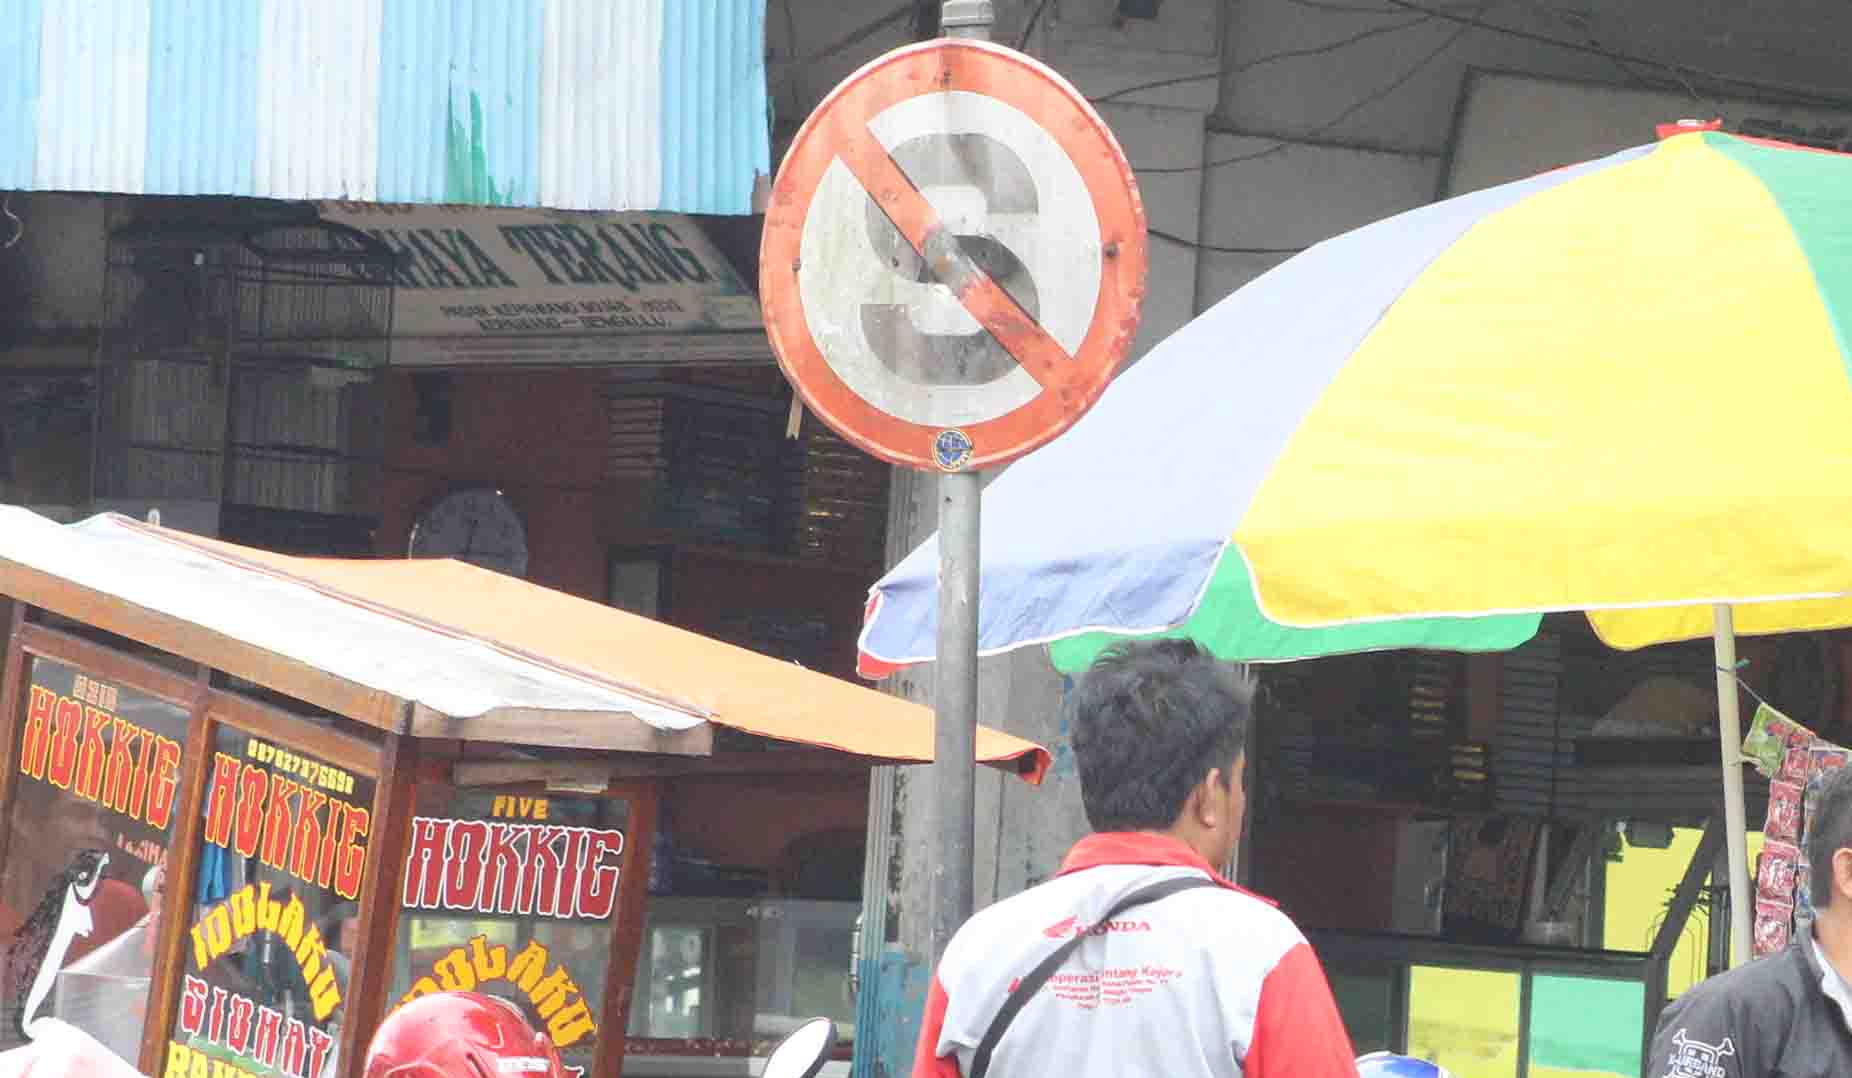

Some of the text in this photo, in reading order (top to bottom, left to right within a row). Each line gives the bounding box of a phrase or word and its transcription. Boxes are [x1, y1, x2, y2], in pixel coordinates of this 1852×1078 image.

[497, 222, 715, 292] TERANG
[21, 684, 181, 830] HOKKIE
[492, 795, 550, 820] FIVE
[204, 752, 369, 900] HOKKIE
[403, 816, 624, 919] HOKKIE
